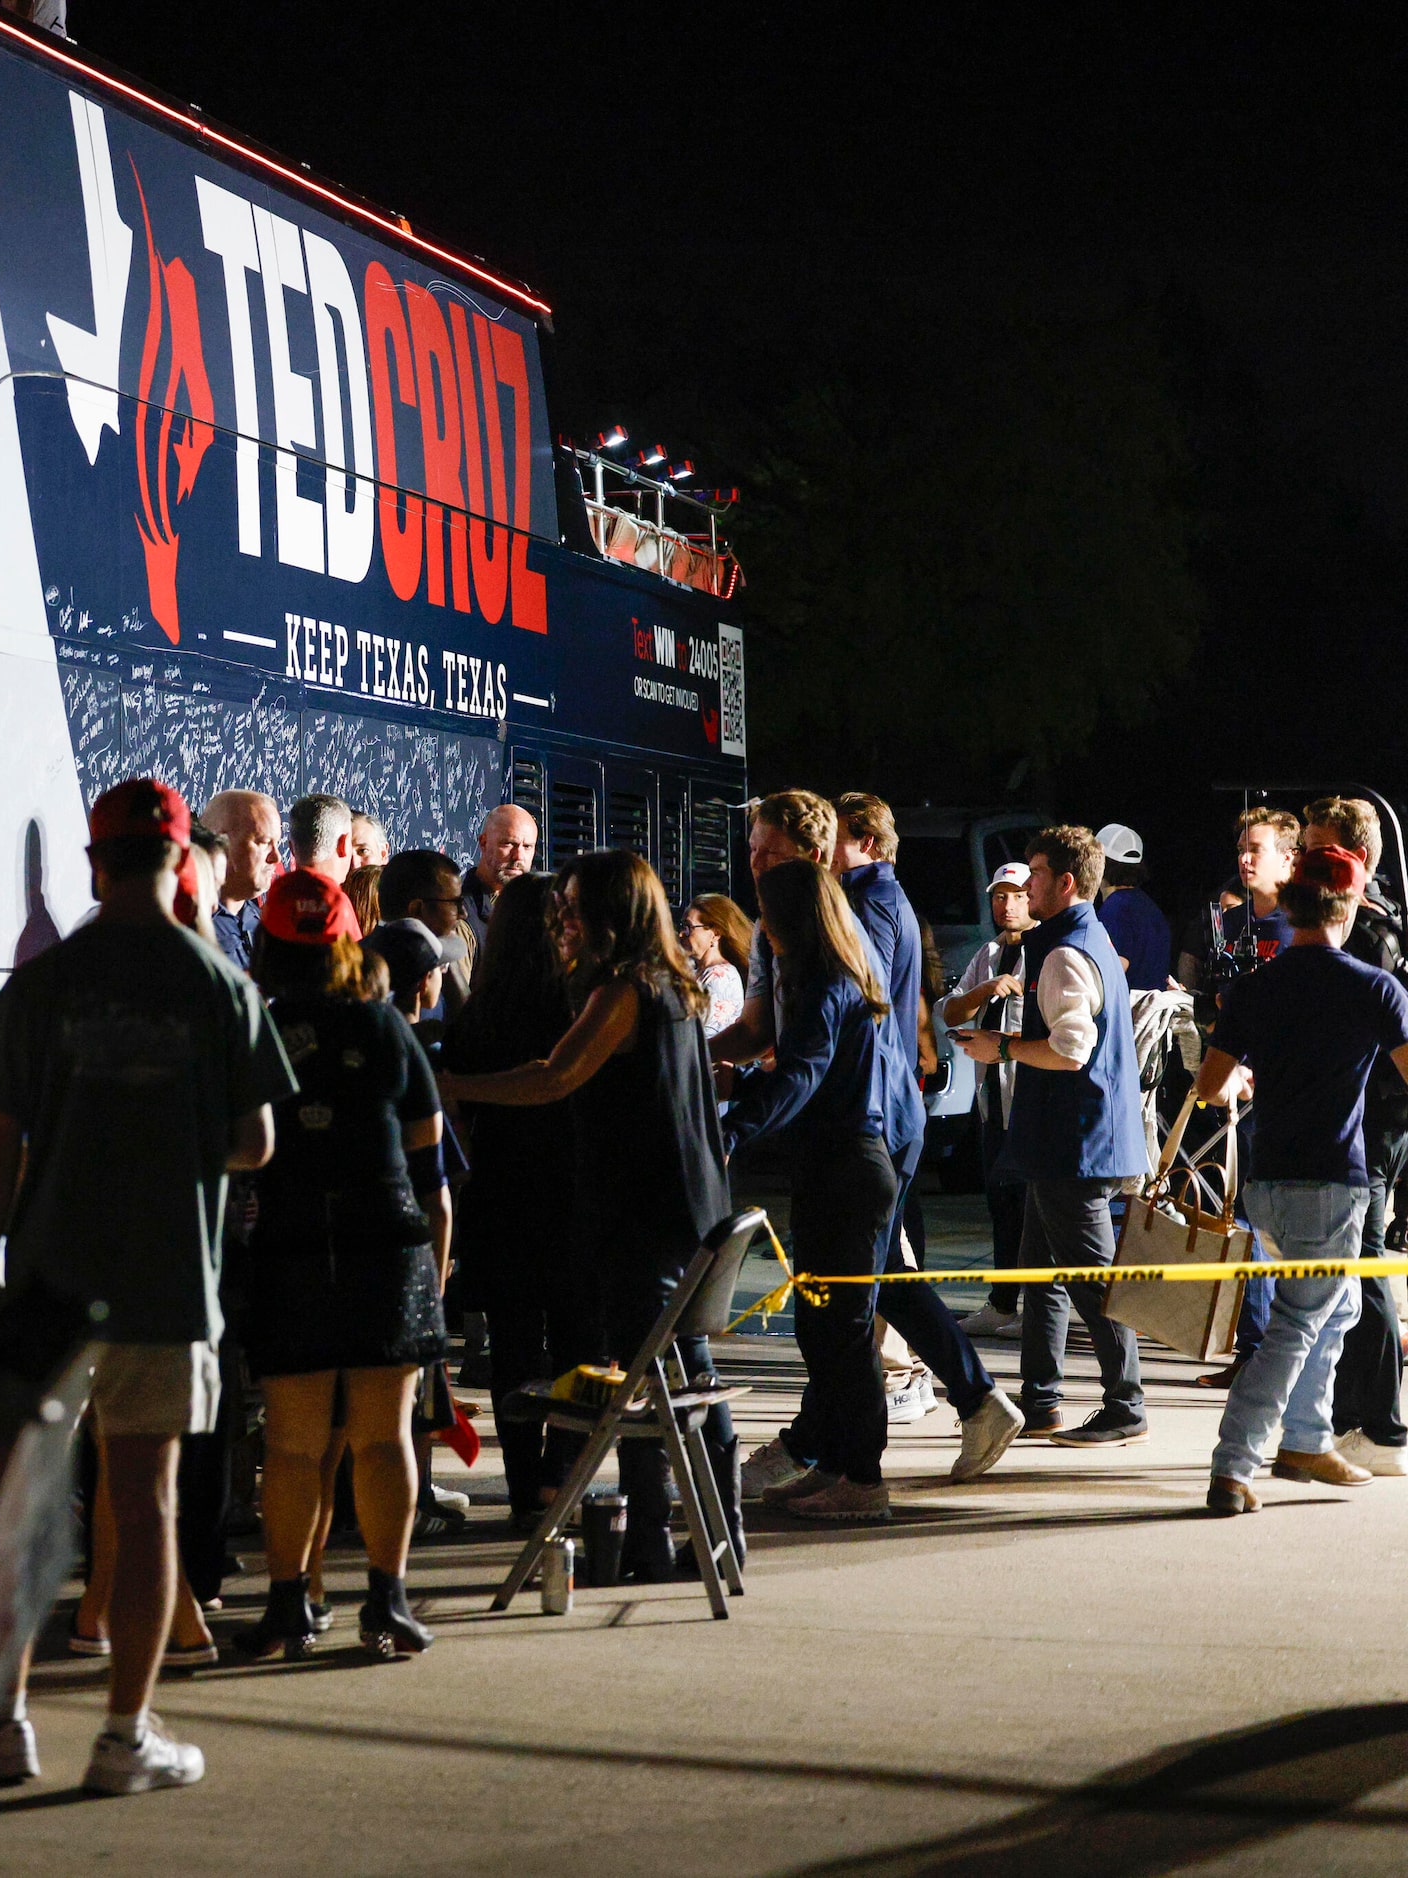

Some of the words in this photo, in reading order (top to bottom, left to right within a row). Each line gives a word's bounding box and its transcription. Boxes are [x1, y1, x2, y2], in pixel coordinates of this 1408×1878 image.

[284, 612, 349, 687] KEEP
[356, 630, 436, 710] TEXAS,
[442, 650, 508, 720] TEXAS
[631, 616, 654, 662] Text
[654, 624, 676, 669] WIN
[677, 640, 688, 672] to
[689, 635, 720, 682] 24005
[633, 675, 643, 698] OR
[643, 678, 657, 701] SCAN
[657, 681, 665, 704] TO
[665, 684, 676, 706] GET
